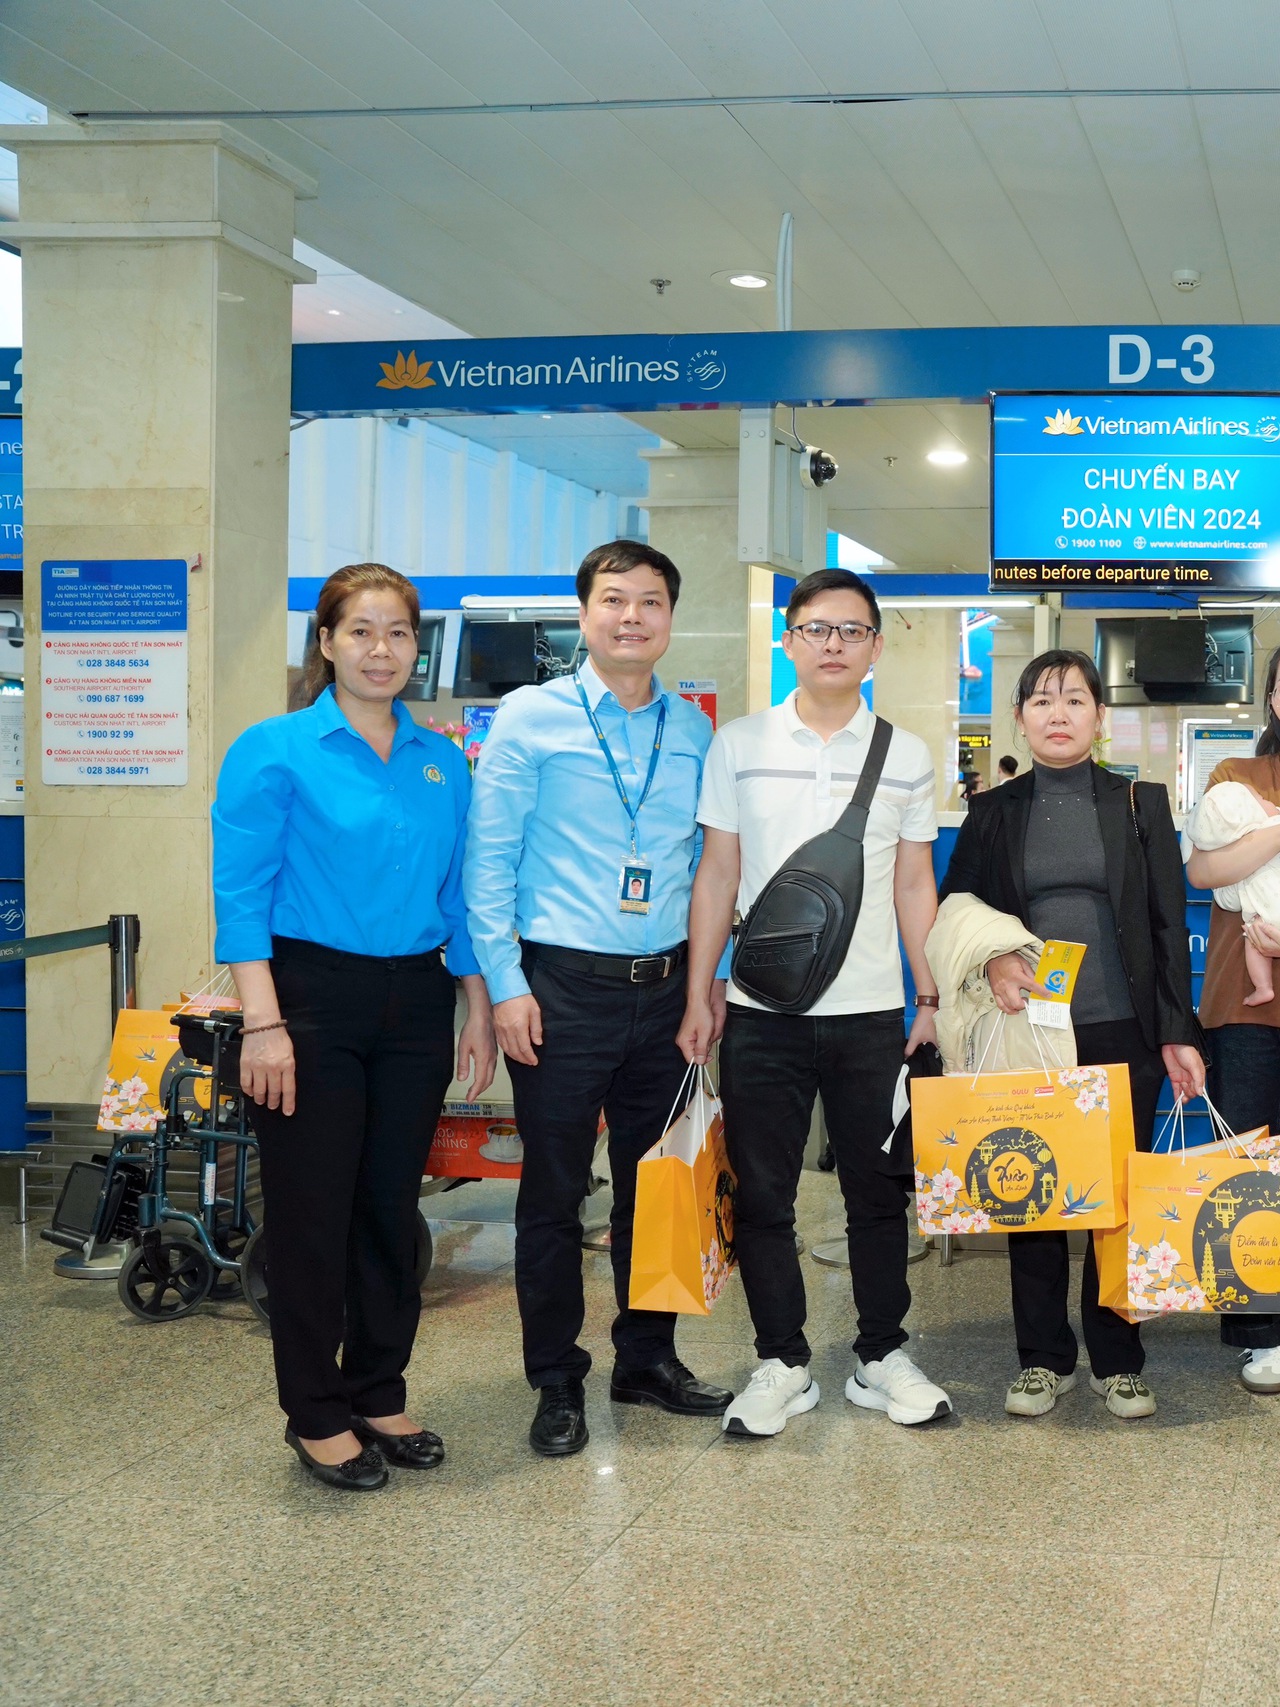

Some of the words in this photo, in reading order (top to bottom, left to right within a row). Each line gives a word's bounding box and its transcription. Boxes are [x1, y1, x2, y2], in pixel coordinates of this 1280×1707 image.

[1108, 334, 1215, 384] D-3
[437, 358, 562, 388] Vietnam
[565, 355, 679, 385] Airlines
[1085, 415, 1170, 435] Vietnam
[1172, 415, 1250, 437] Airlines
[1084, 462, 1186, 491] CHUYẾN
[1193, 469, 1240, 490] BAY
[1061, 503, 1132, 530] ĐOÀN
[1140, 503, 1195, 530] VIÊN
[1203, 508, 1261, 530] 2024
[1071, 537, 1096, 548] 1900
[1149, 538, 1268, 550] www.vietnamairlines.com
[1041, 565, 1091, 580] before
[1095, 566, 1170, 583] departure
[1174, 566, 1213, 581] time.
